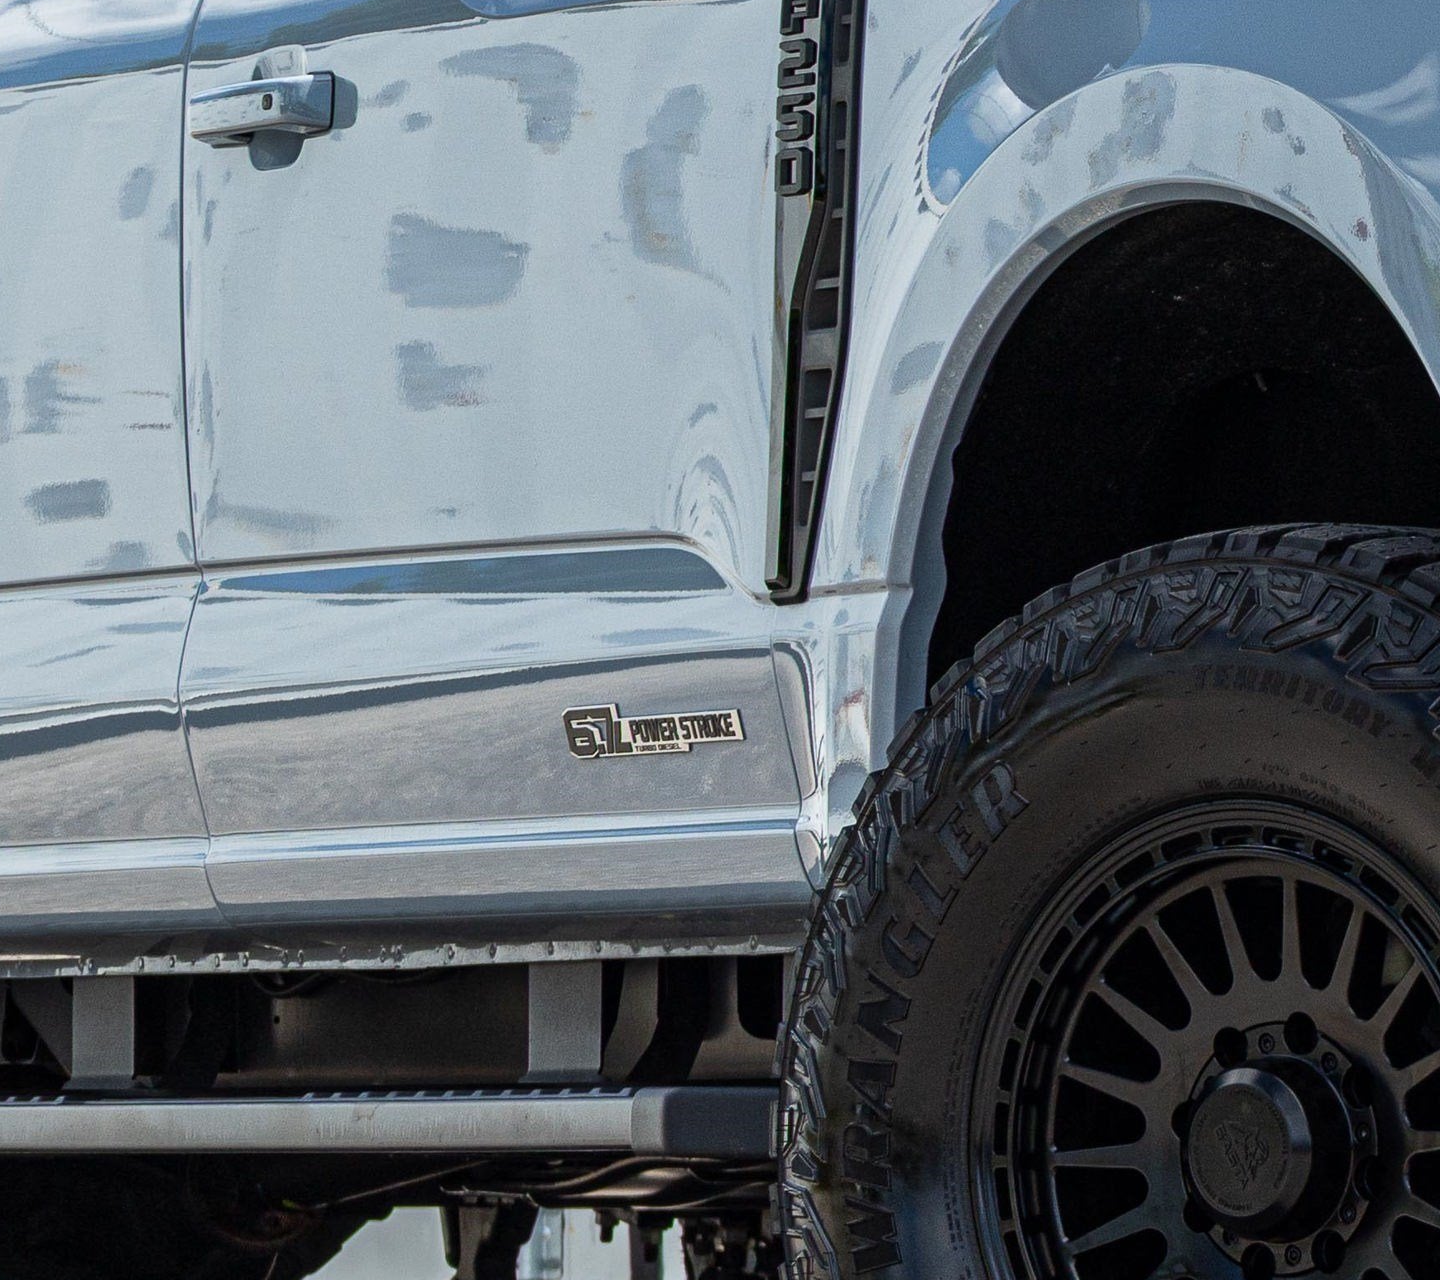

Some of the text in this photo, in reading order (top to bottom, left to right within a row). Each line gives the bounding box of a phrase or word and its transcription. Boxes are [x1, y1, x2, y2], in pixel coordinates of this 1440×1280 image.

[628, 717, 680, 743] POWER
[678, 713, 736, 740] STROKE
[1192, 663, 1397, 738] TERRITORY
[841, 759, 1031, 1275] WRANGLER
